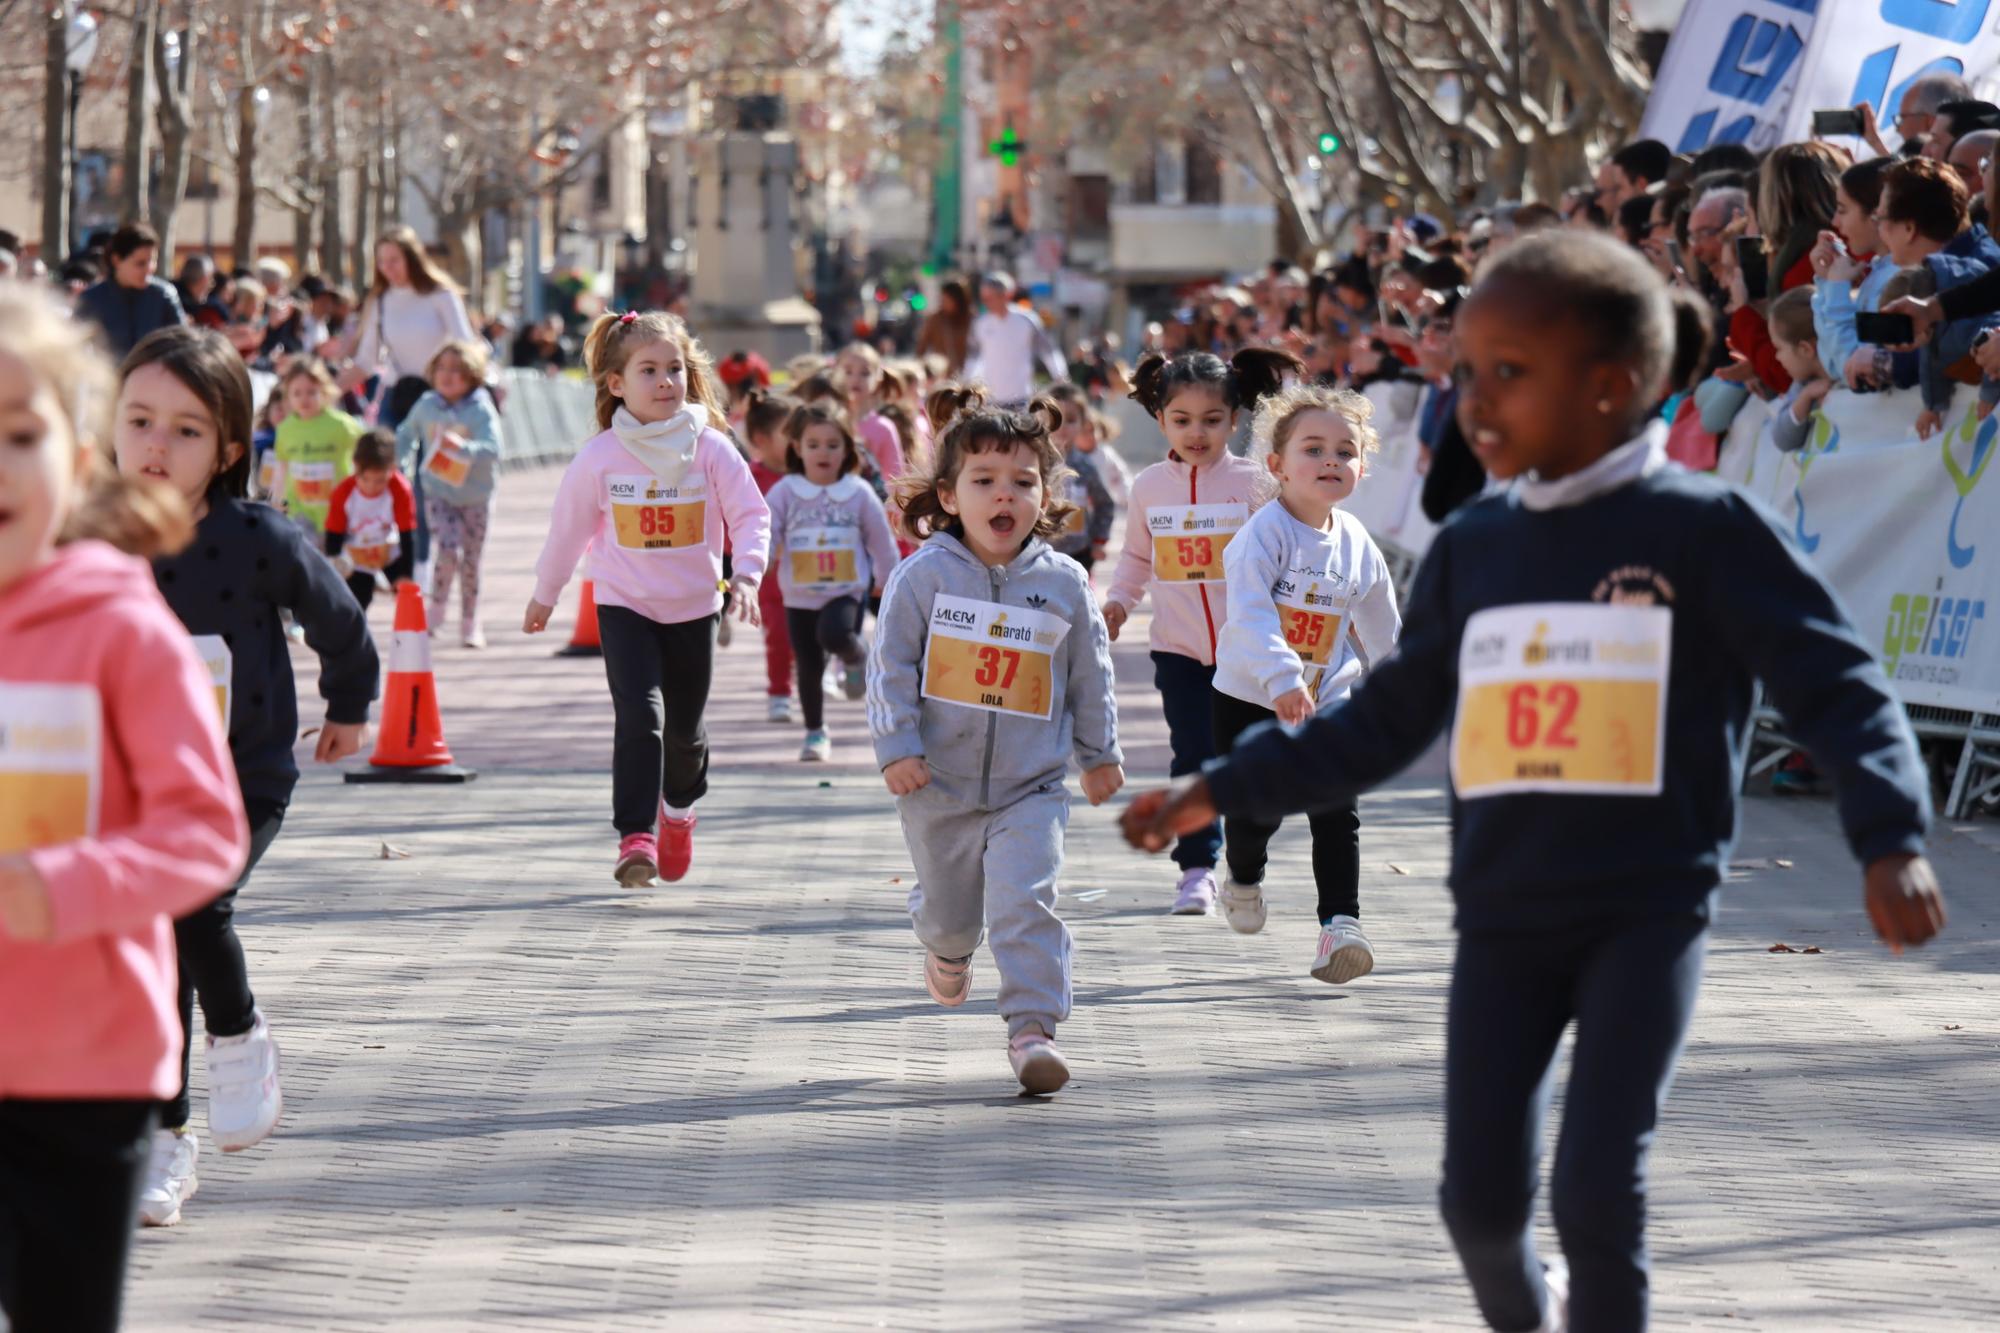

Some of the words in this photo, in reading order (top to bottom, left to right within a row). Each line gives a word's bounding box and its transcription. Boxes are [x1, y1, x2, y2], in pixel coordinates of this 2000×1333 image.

[646, 487, 678, 499] marató
[640, 506, 675, 536] 85
[1183, 517, 1215, 531] marató
[817, 551, 836, 573] 11
[1177, 536, 1213, 568] 53
[935, 608, 975, 624] SALERA
[1287, 611, 1325, 647] 35
[1883, 577, 1984, 680] geiser
[990, 623, 1031, 642] marató
[975, 646, 1021, 690] 37
[981, 692, 1003, 707] LOLA
[1506, 680, 1581, 751] 62
